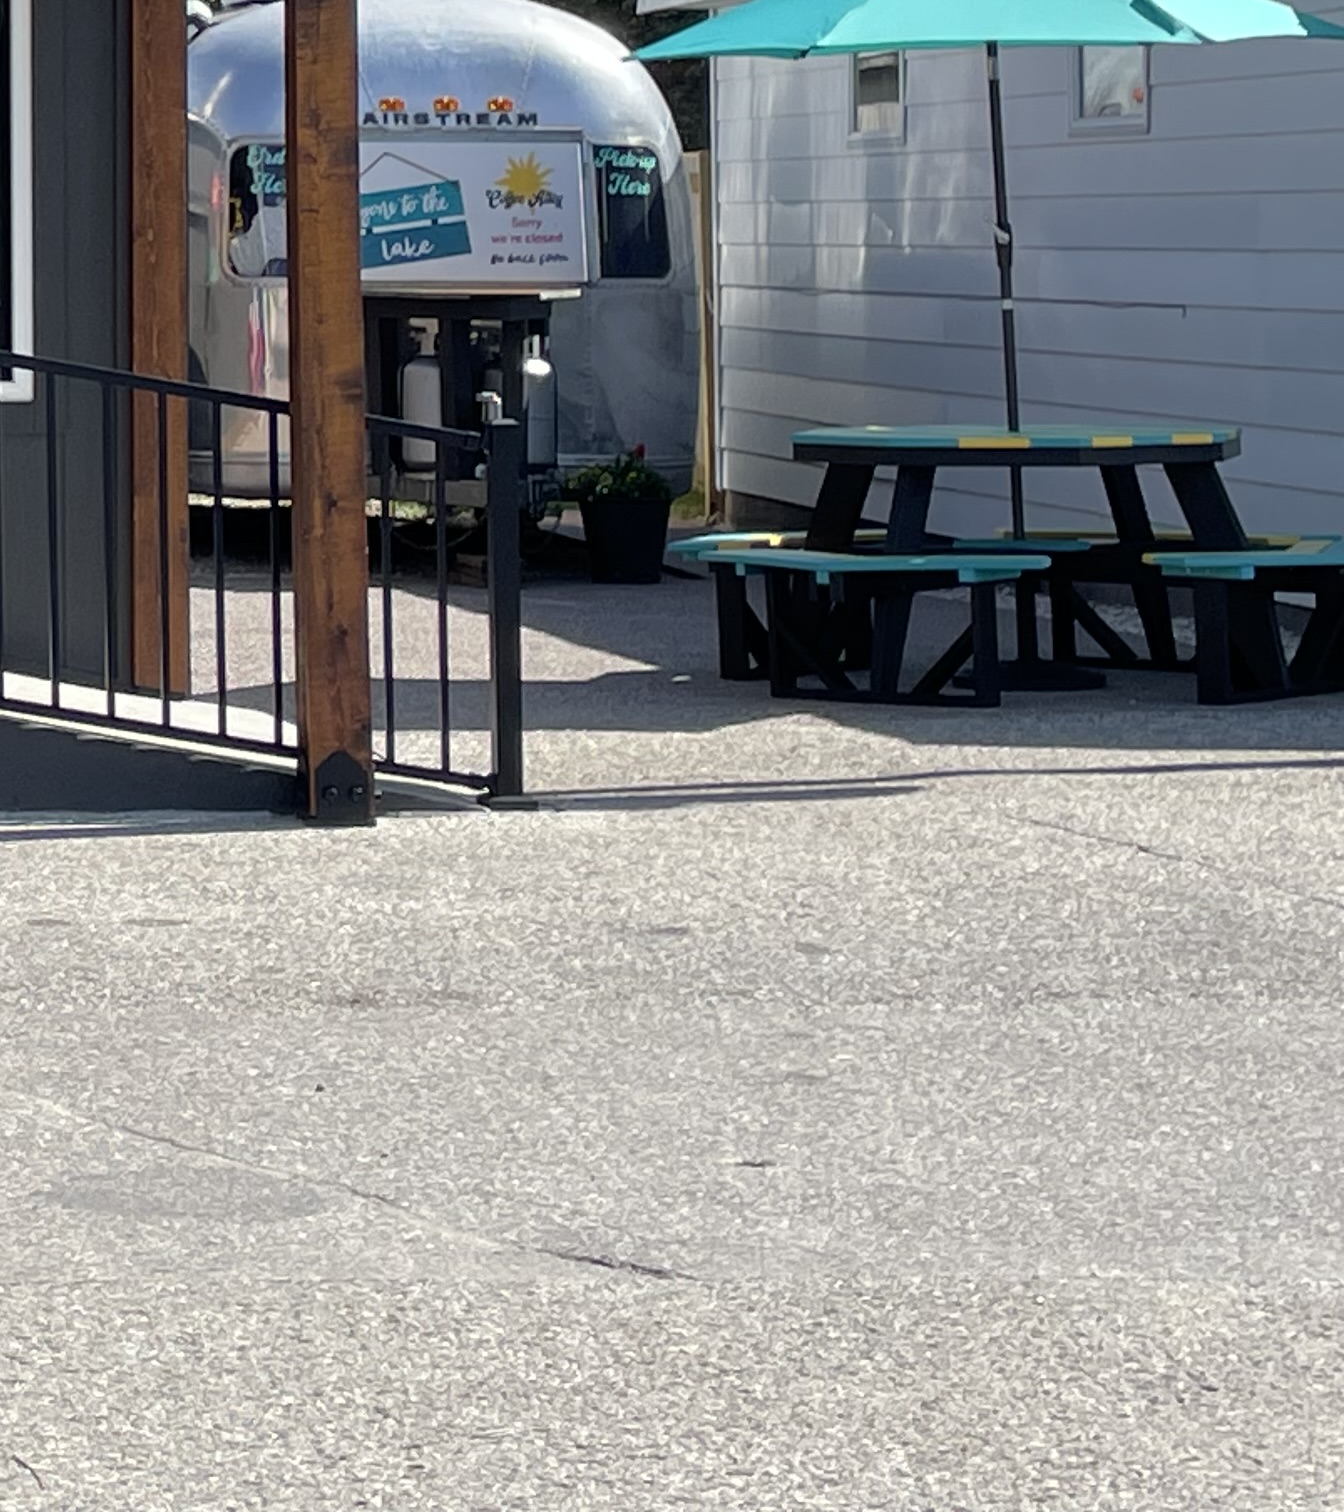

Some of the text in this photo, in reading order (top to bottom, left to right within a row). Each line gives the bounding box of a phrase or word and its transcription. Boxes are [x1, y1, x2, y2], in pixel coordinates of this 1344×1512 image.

[363, 112, 538, 126] AIRSTREAM
[398, 193, 419, 217] to
[421, 186, 450, 214] the
[512, 216, 543, 229] Sorry
[381, 236, 436, 262] lake
